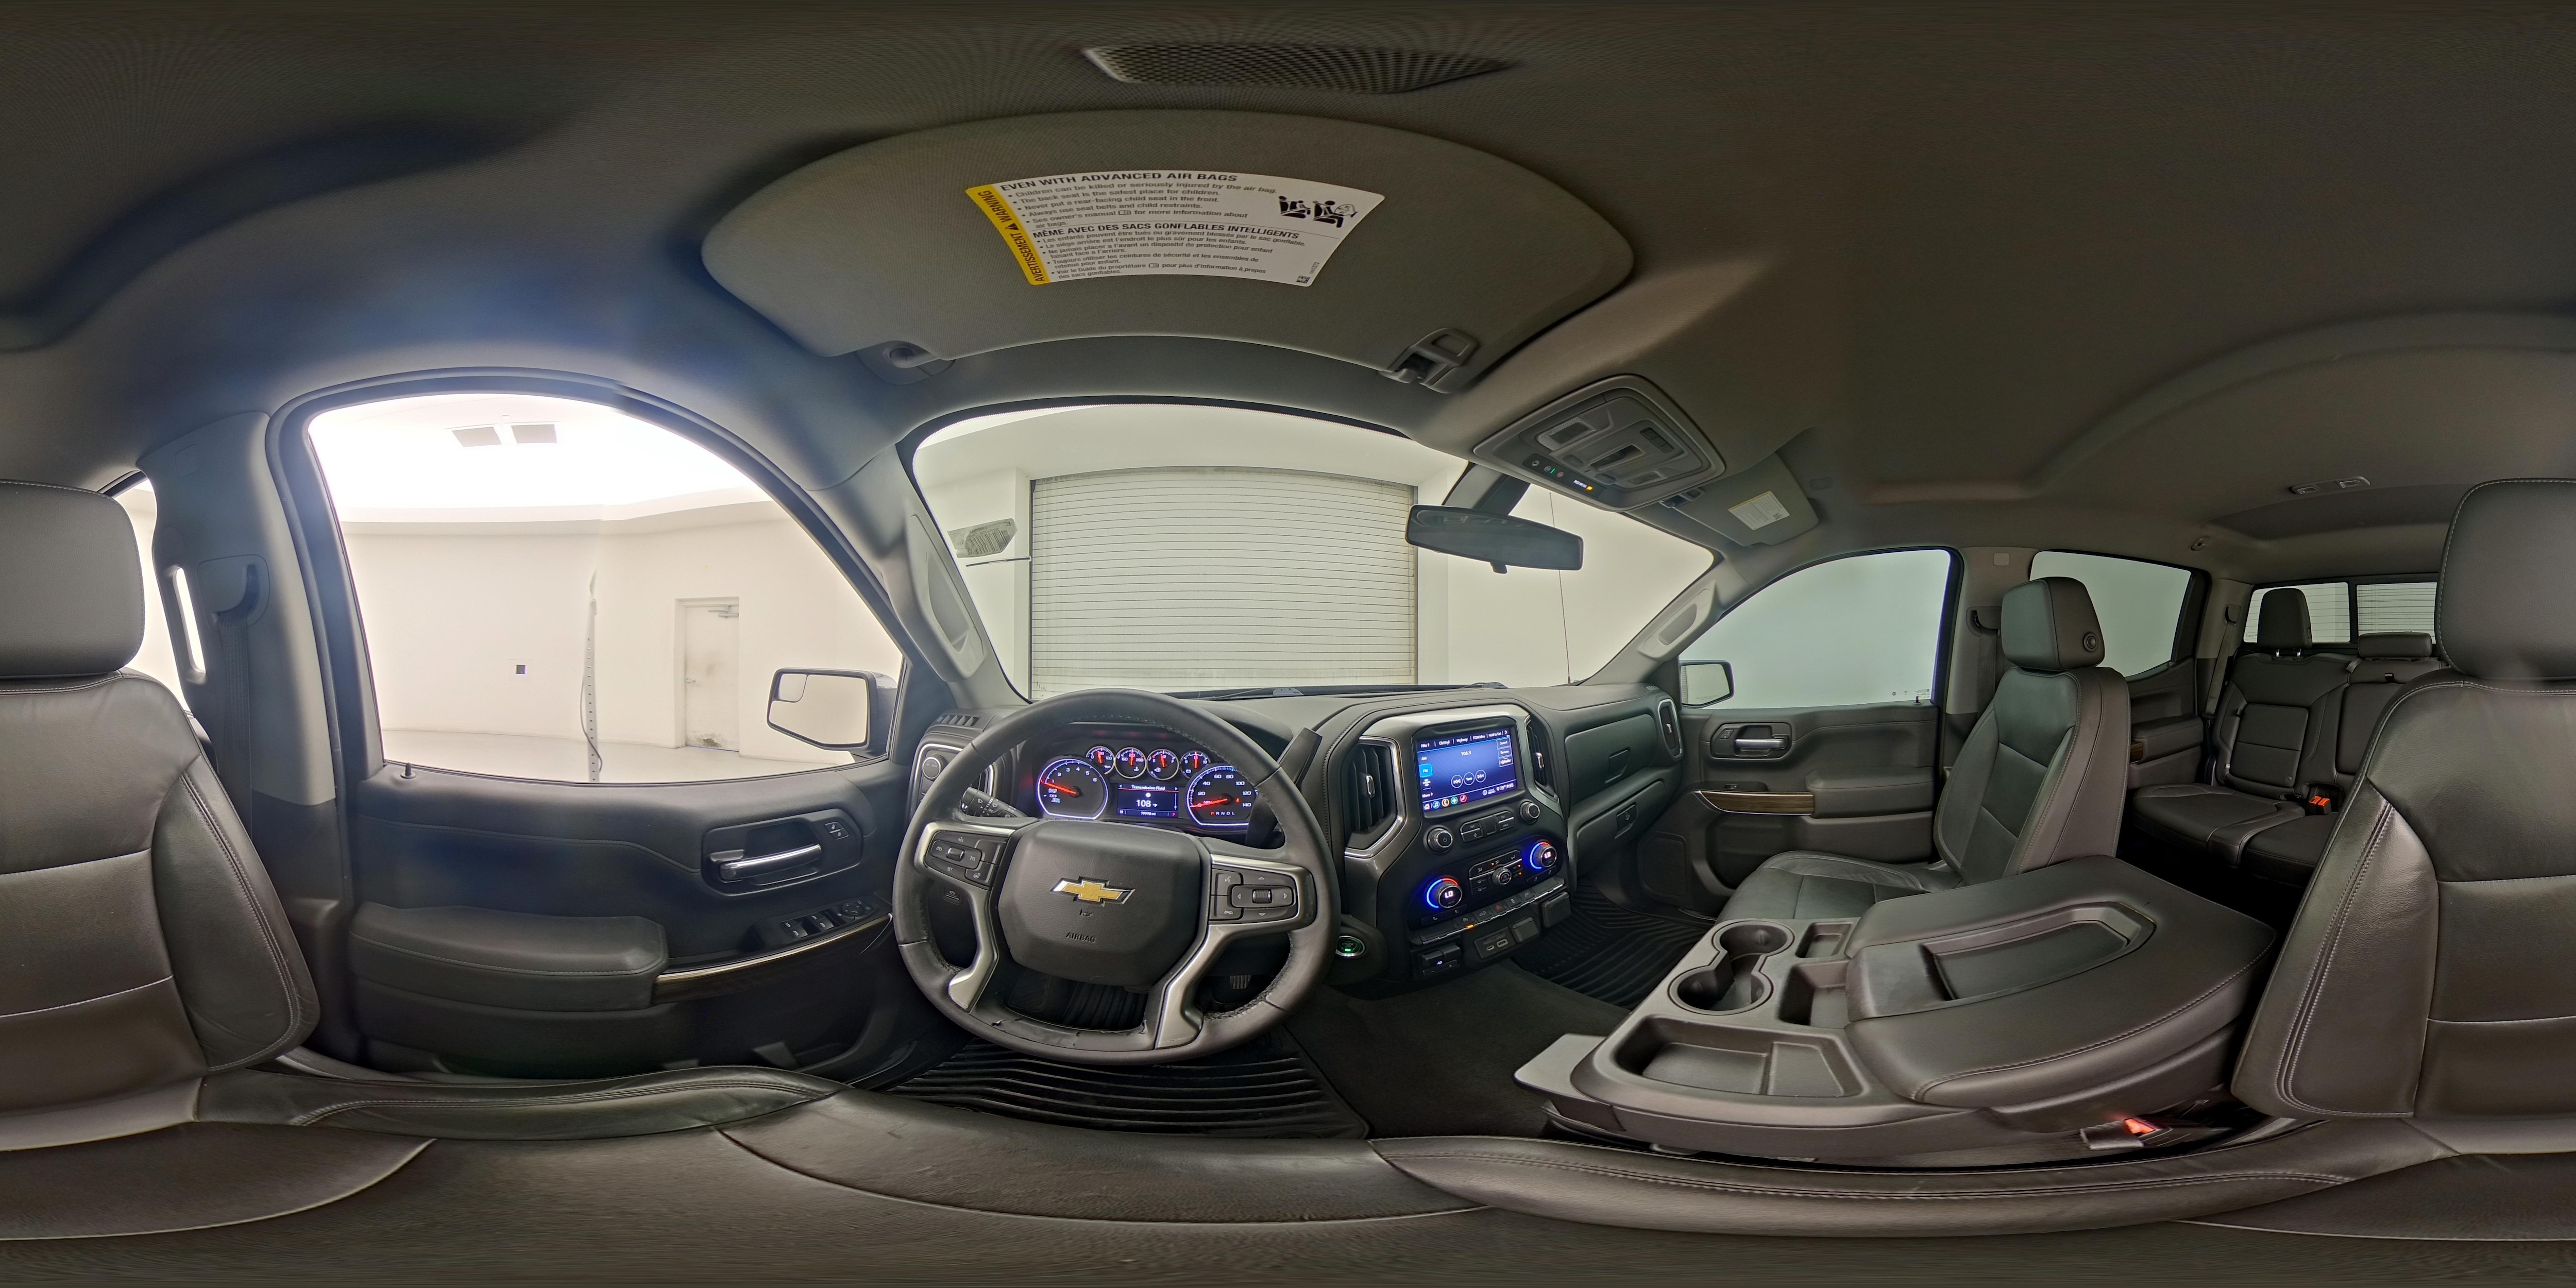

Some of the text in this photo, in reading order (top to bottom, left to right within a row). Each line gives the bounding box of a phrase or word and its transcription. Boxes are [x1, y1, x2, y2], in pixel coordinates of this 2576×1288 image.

[1001, 181, 1037, 191] EVEN
[1039, 177, 1077, 185] WITH
[1081, 173, 1161, 181] ADVANCED
[1015, 189, 1053, 197] Children
[978, 191, 1012, 223] WARNING
[1033, 229, 1064, 238] MÊME
[1228, 226, 1299, 239] INTELLIGENTS
[1273, 238, 1305, 246] gonflable.
[1010, 233, 1045, 281] AVERTISSEMENT
[1445, 890, 1453, 899] LO
[1065, 932, 1096, 943] AIRBAG
